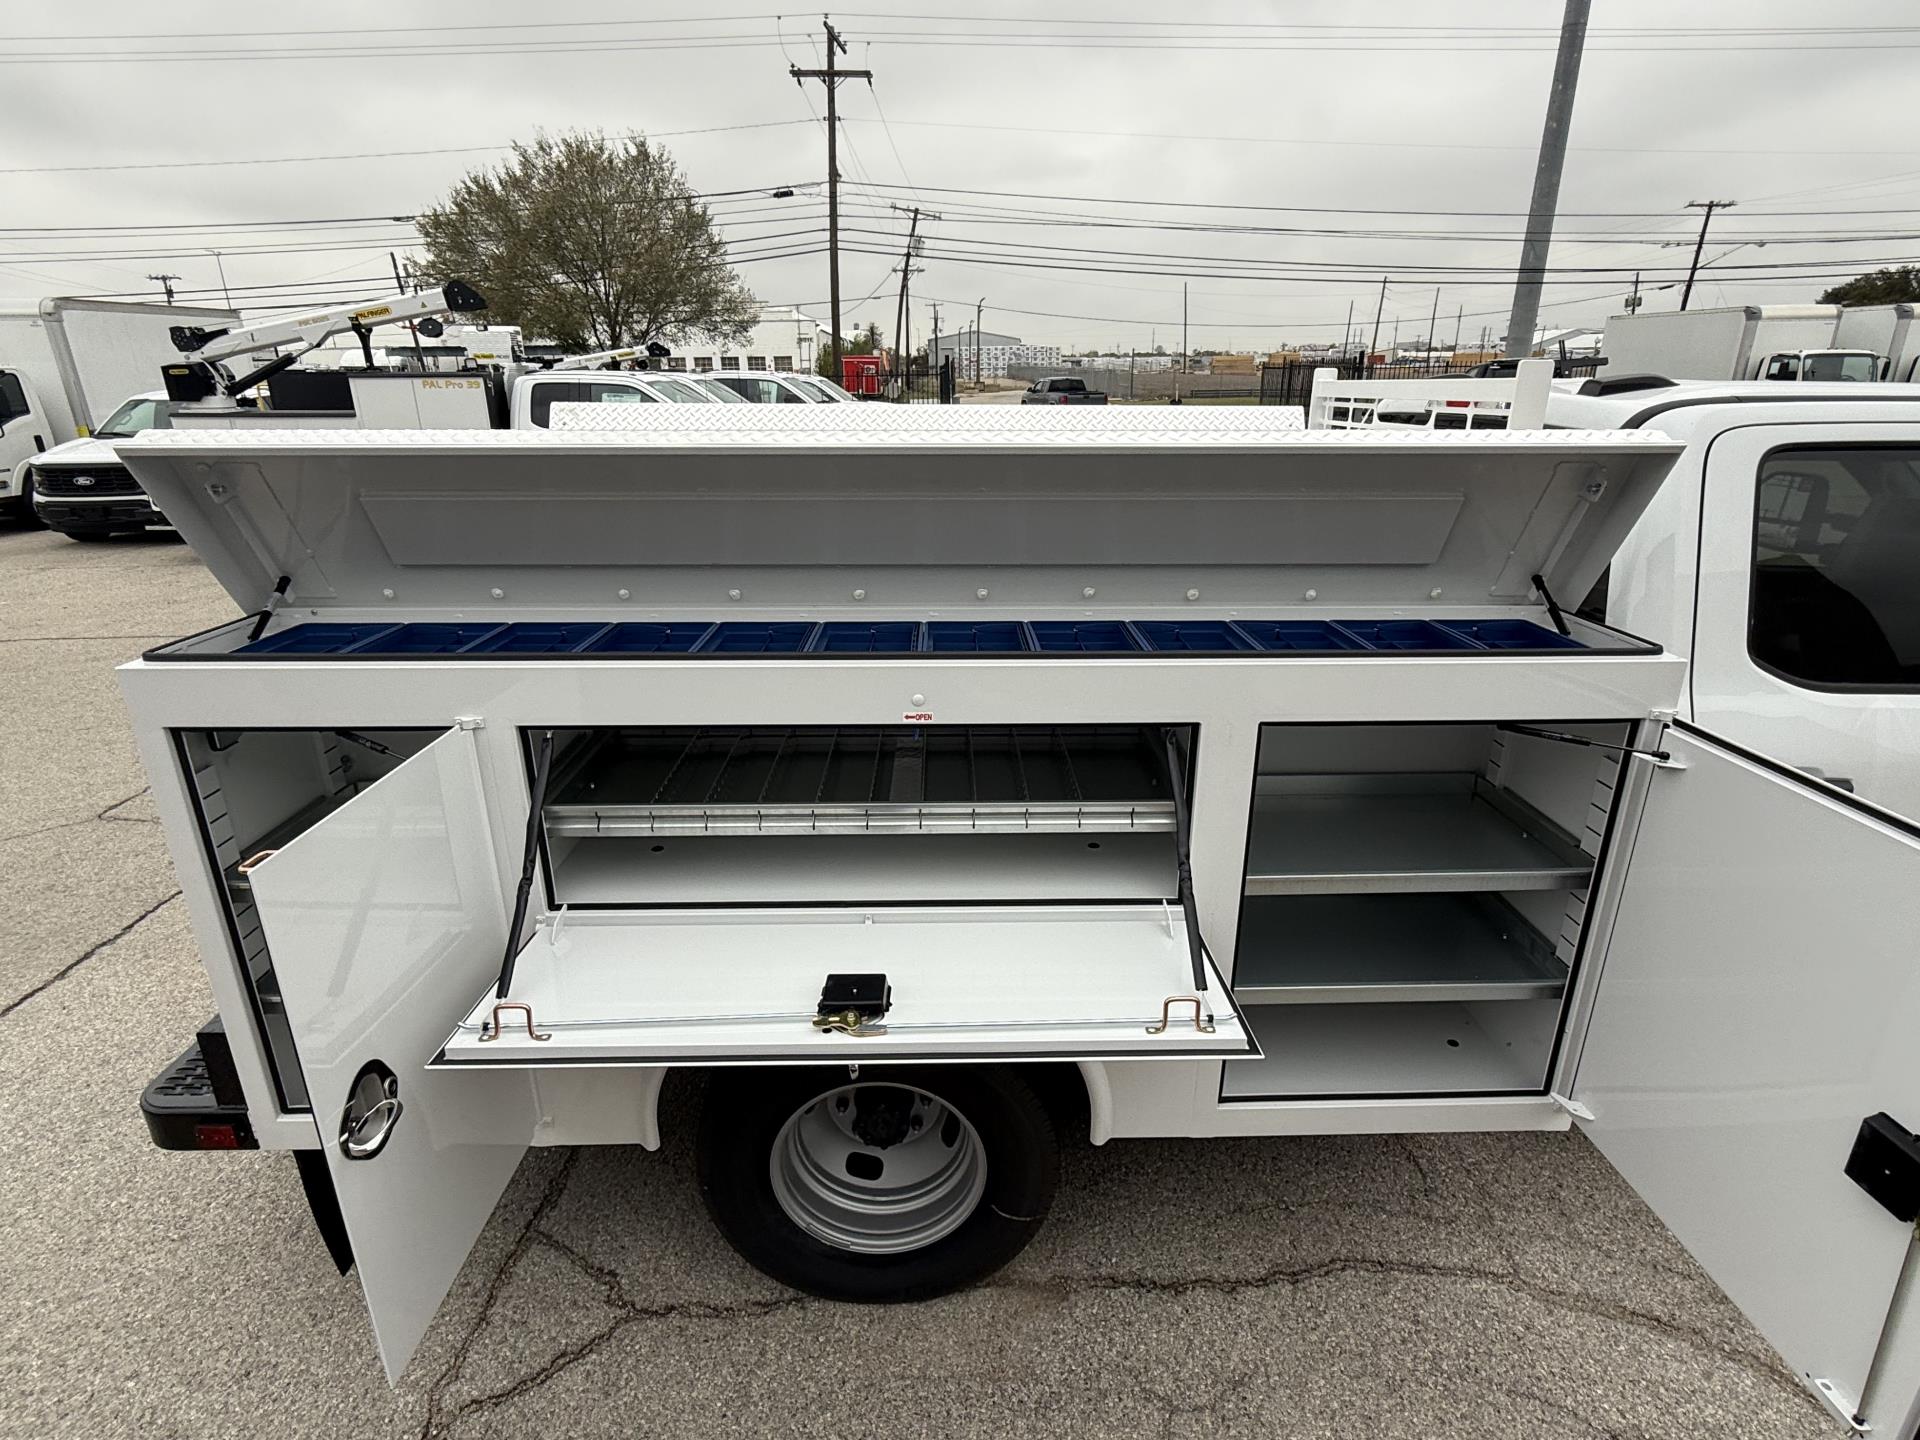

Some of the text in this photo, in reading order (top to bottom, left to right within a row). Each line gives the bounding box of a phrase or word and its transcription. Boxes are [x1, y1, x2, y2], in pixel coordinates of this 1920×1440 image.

[422, 380, 480, 389] PAL Pro 39
[915, 713, 932, 721] OPEN
